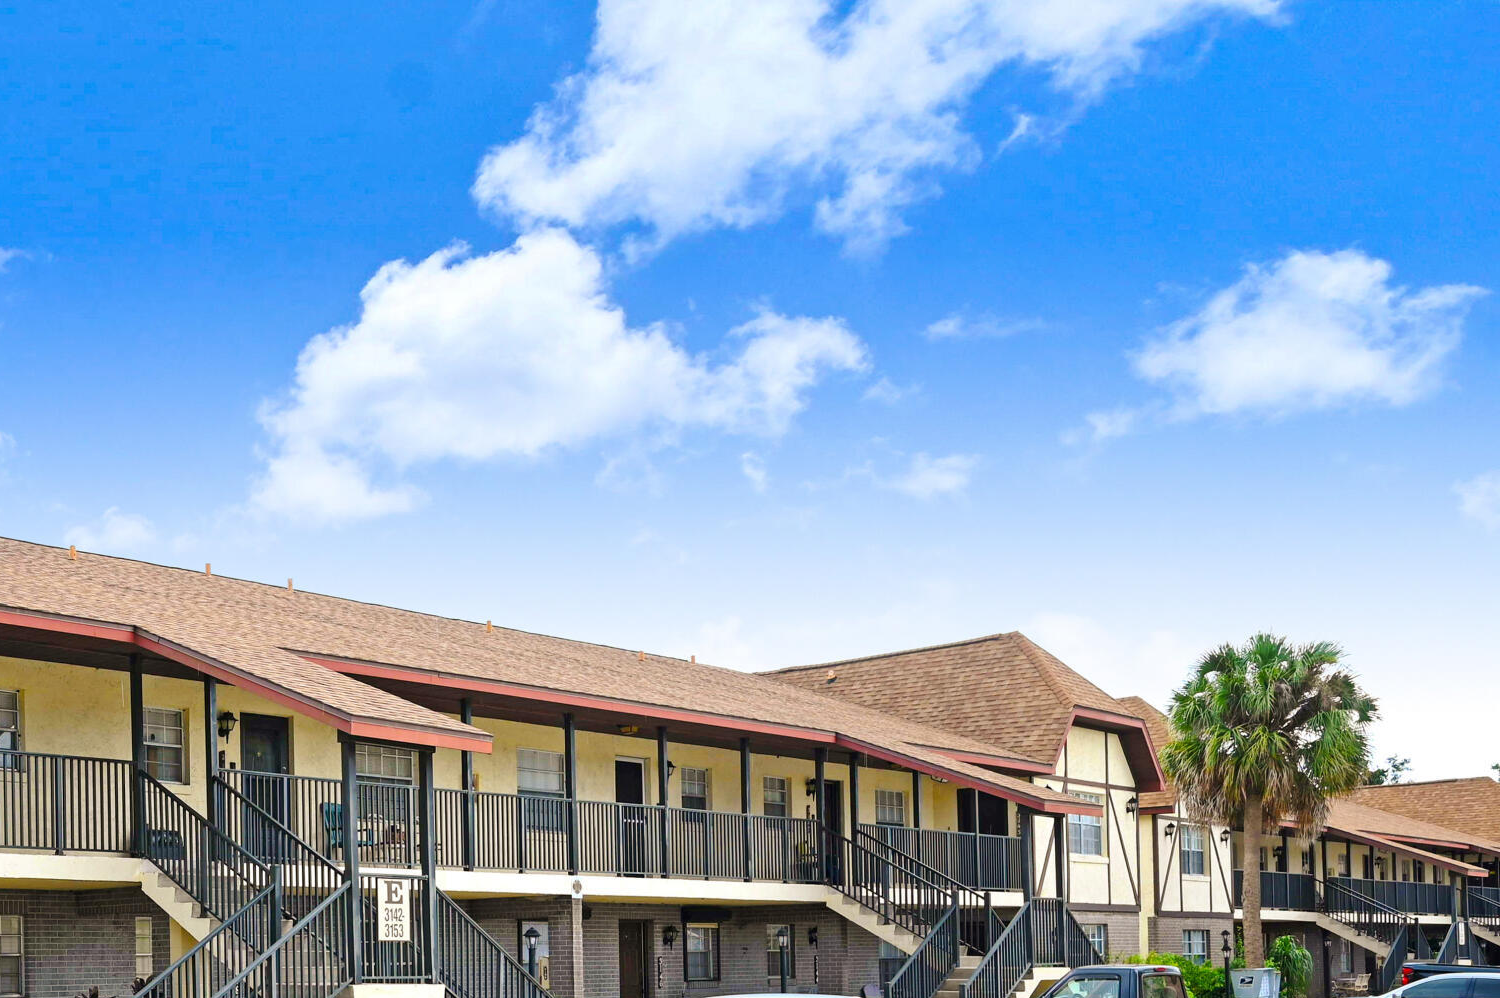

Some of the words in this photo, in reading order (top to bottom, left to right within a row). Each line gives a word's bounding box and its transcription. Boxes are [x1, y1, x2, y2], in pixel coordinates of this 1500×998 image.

[384, 880, 404, 905] E
[384, 907, 405, 922] 3142-
[384, 923, 404, 938] 3153
